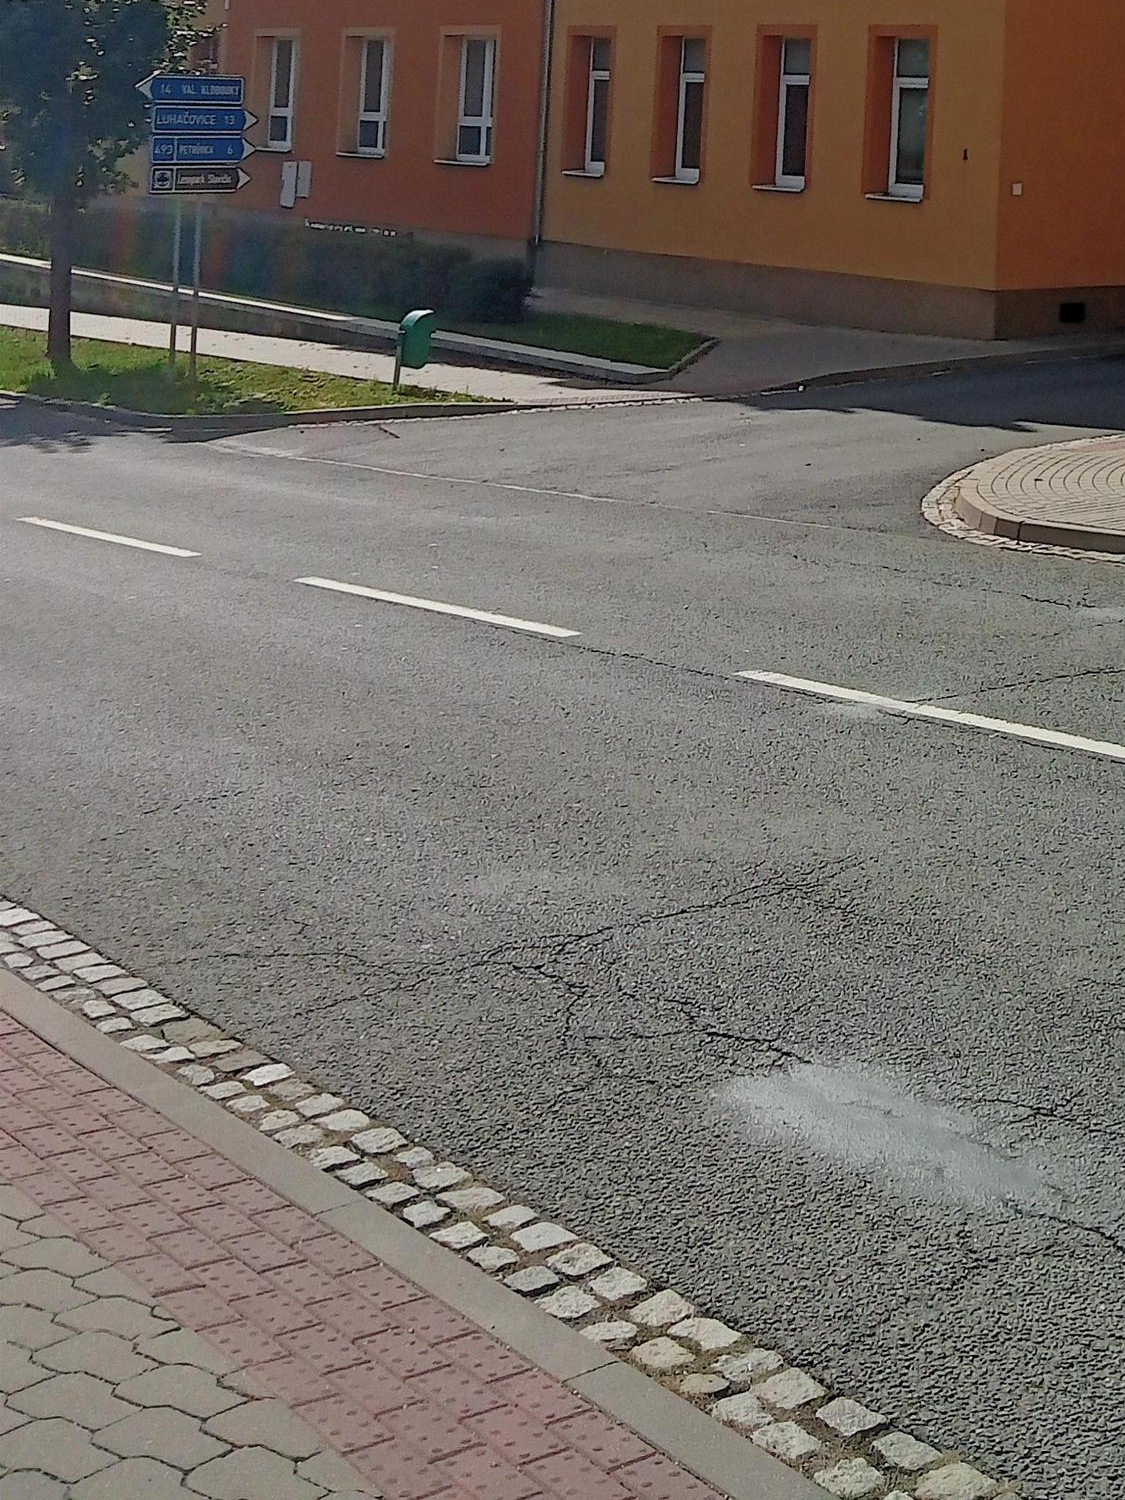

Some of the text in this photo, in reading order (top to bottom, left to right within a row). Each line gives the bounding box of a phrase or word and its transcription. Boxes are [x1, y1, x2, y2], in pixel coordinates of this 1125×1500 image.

[161, 84, 171, 94] 14
[156, 110, 235, 125] LUHAČOVICE 13
[154, 145, 174, 155] 493
[226, 146, 234, 155] 6
